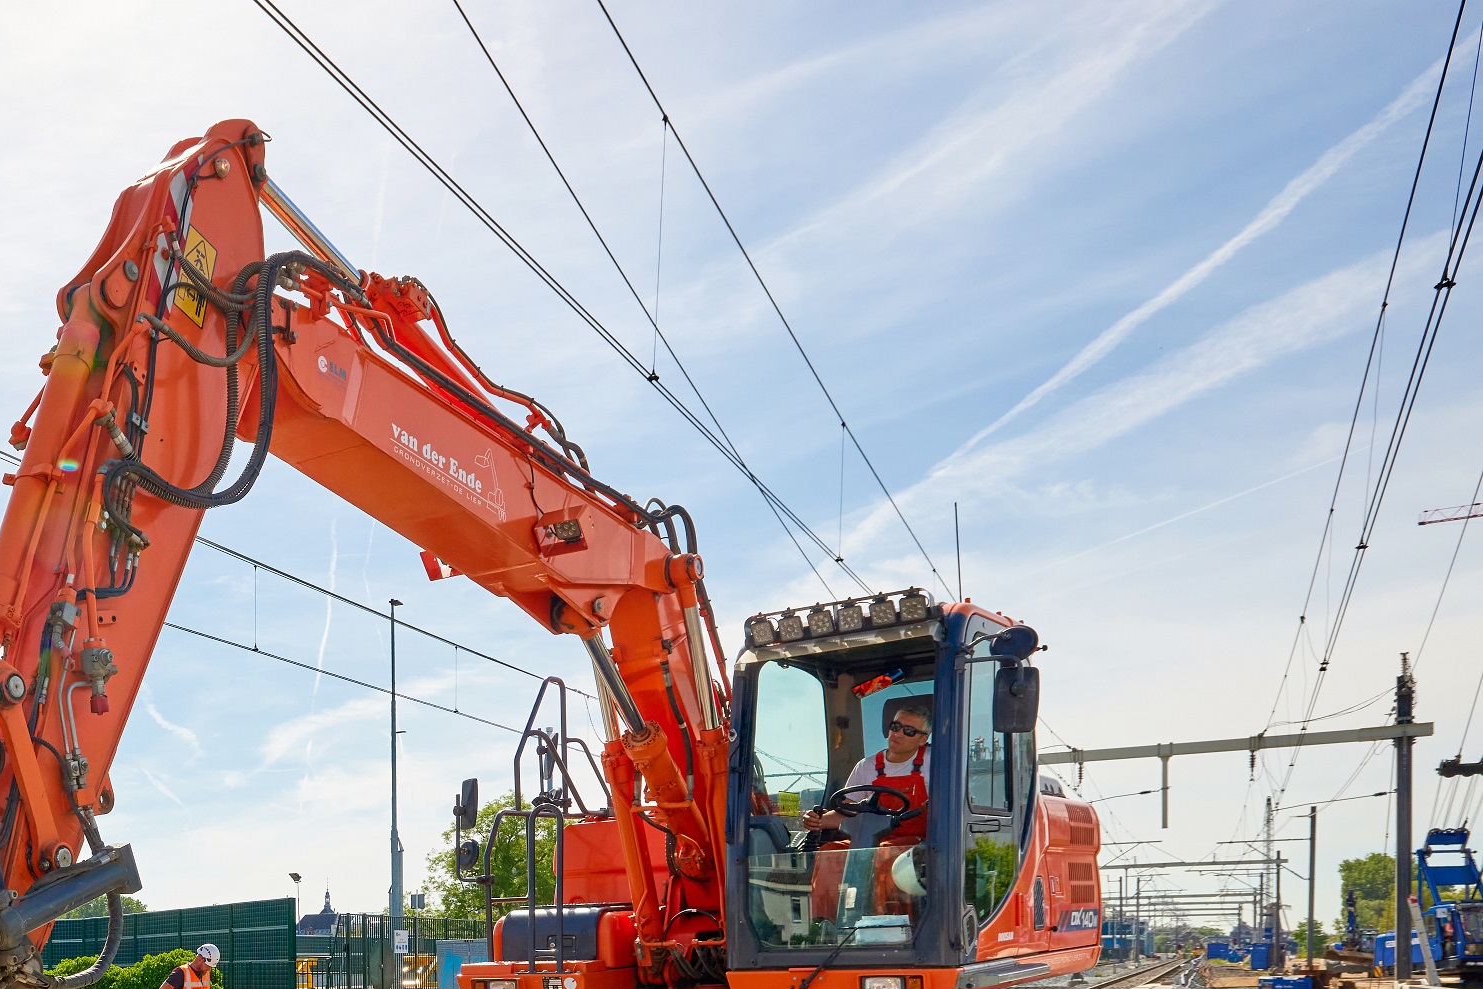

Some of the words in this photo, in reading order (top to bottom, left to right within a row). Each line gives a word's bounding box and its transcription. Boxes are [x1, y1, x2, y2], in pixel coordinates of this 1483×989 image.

[392, 423, 418, 452] van
[422, 443, 446, 468] der
[449, 457, 482, 493] Ende
[466, 493, 482, 507] LIER
